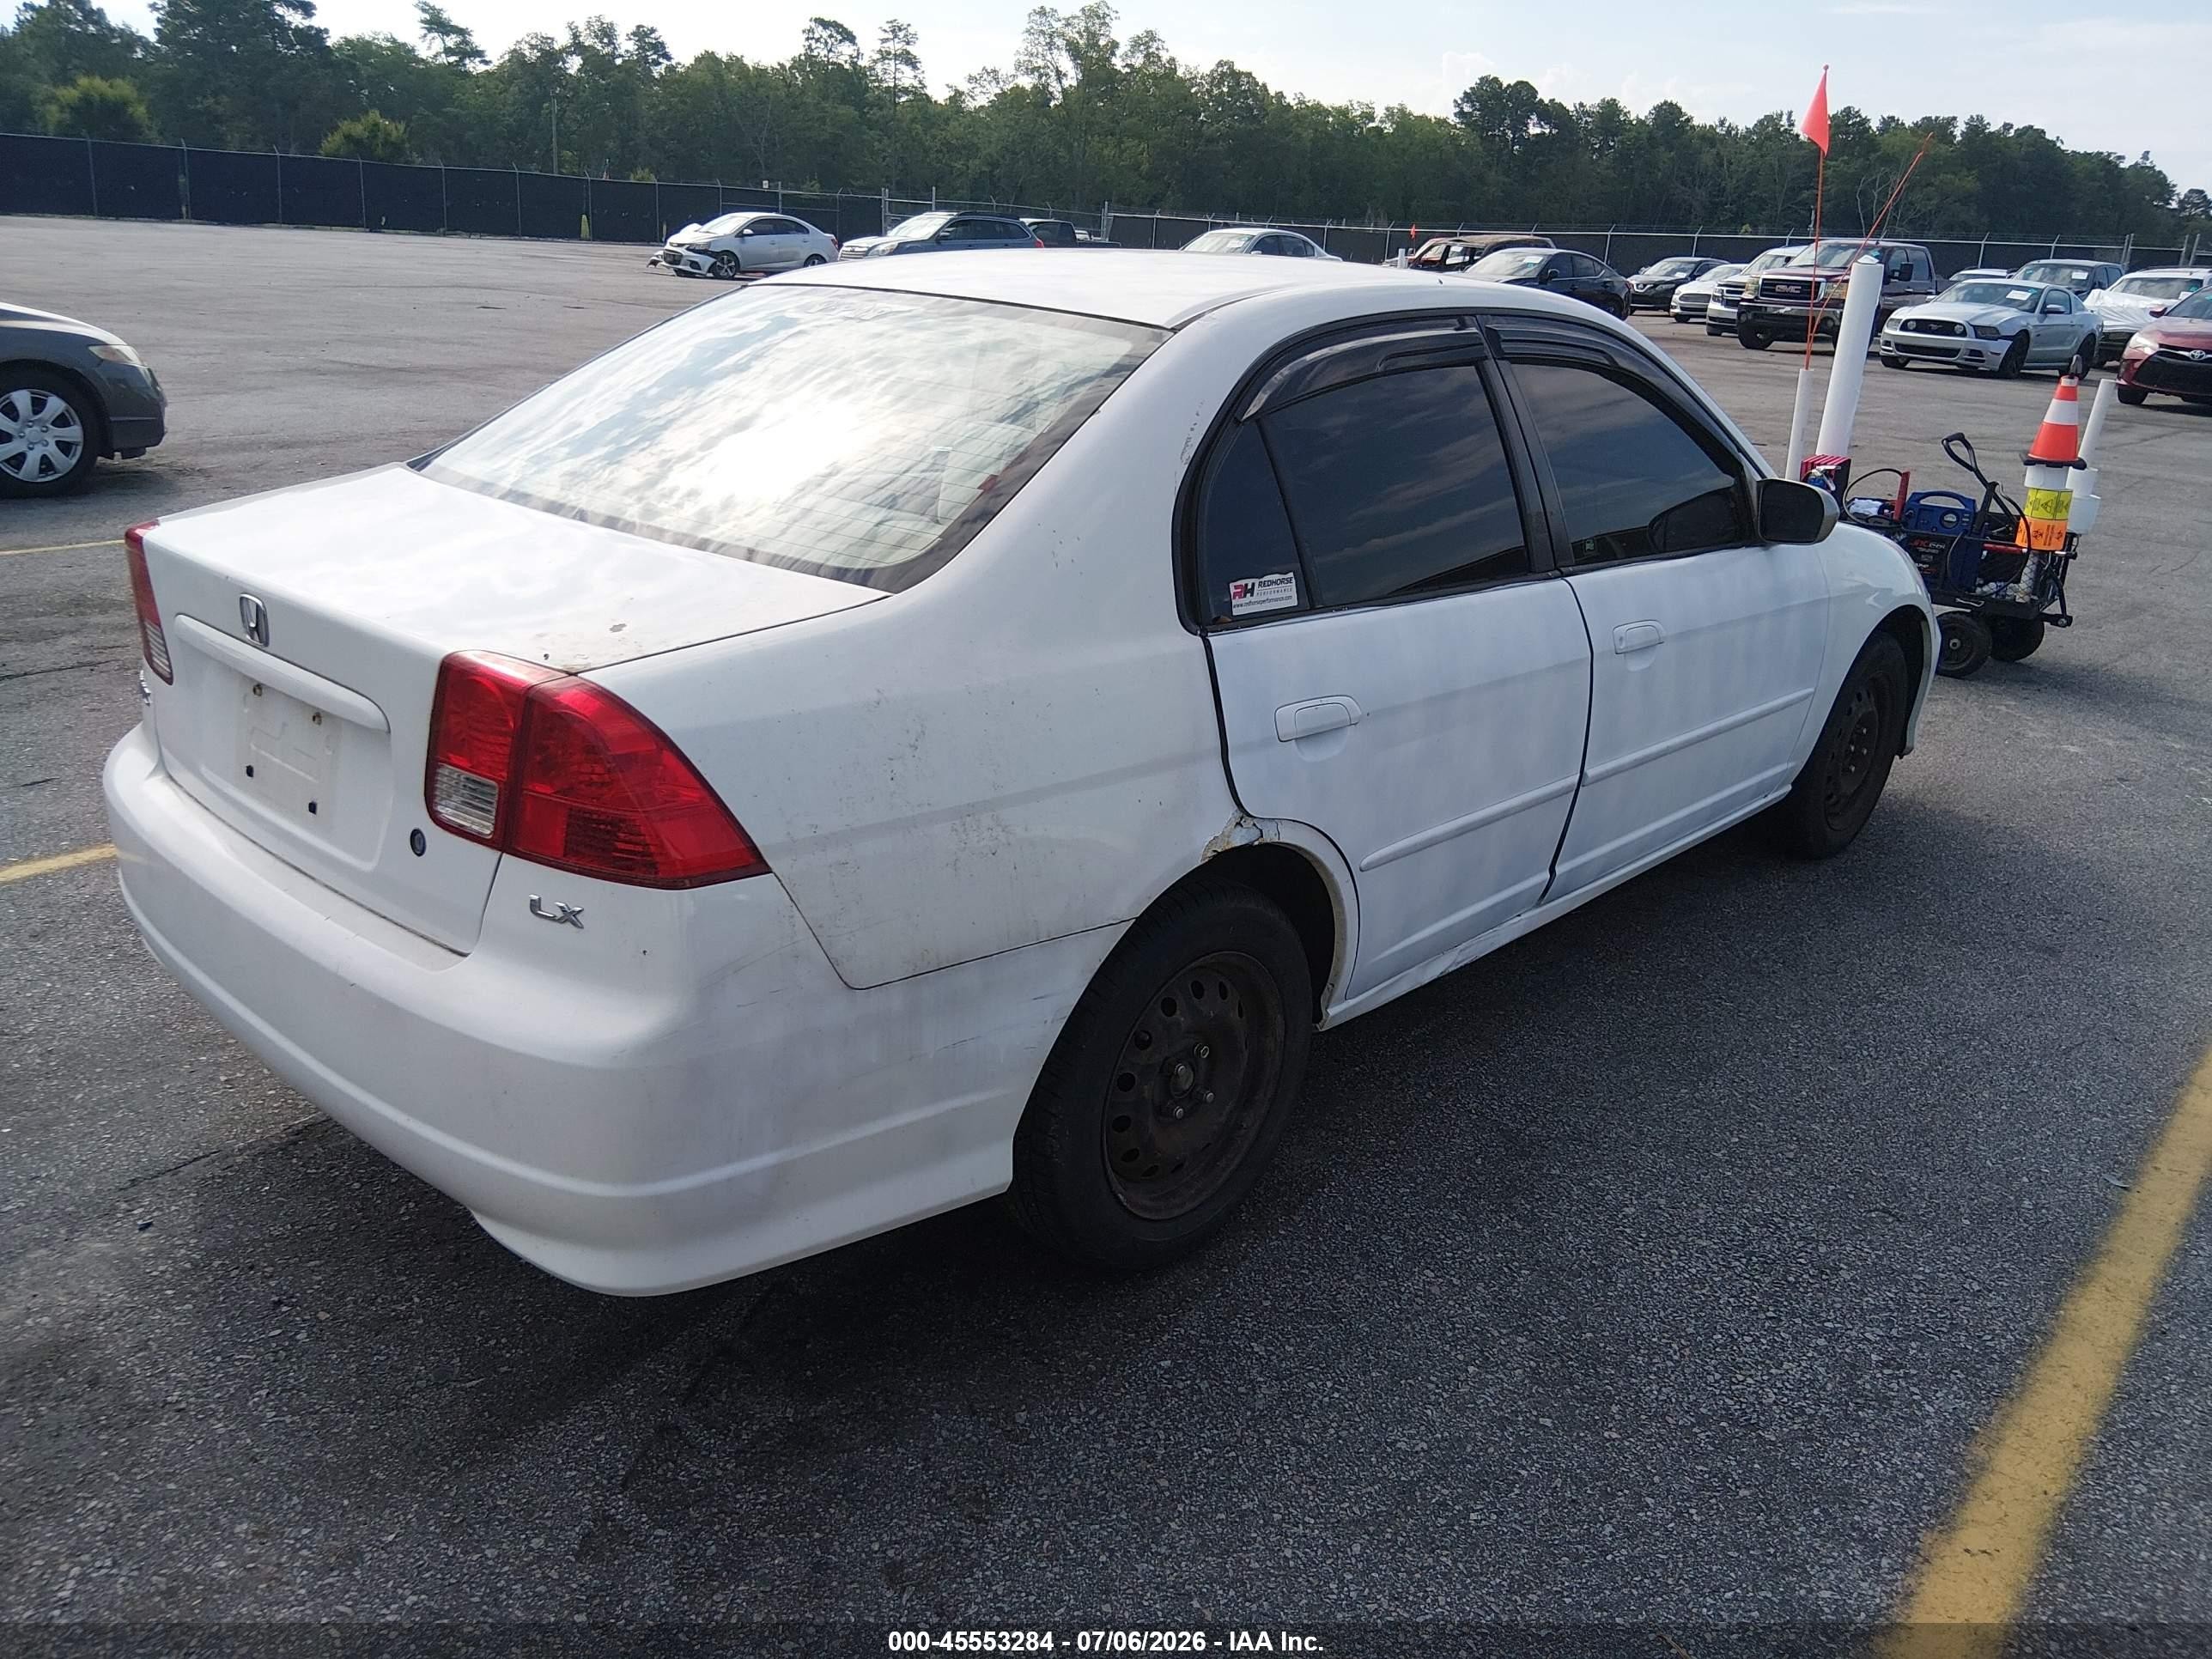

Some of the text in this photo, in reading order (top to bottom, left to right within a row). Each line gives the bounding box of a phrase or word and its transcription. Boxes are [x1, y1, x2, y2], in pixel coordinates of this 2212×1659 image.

[1775, 284, 1802, 294] GMC
[1257, 576, 1294, 589] REDHORSE
[1233, 582, 1255, 600] RH
[1256, 586, 1292, 597] PERFORMANCE
[529, 894, 585, 929] LX
